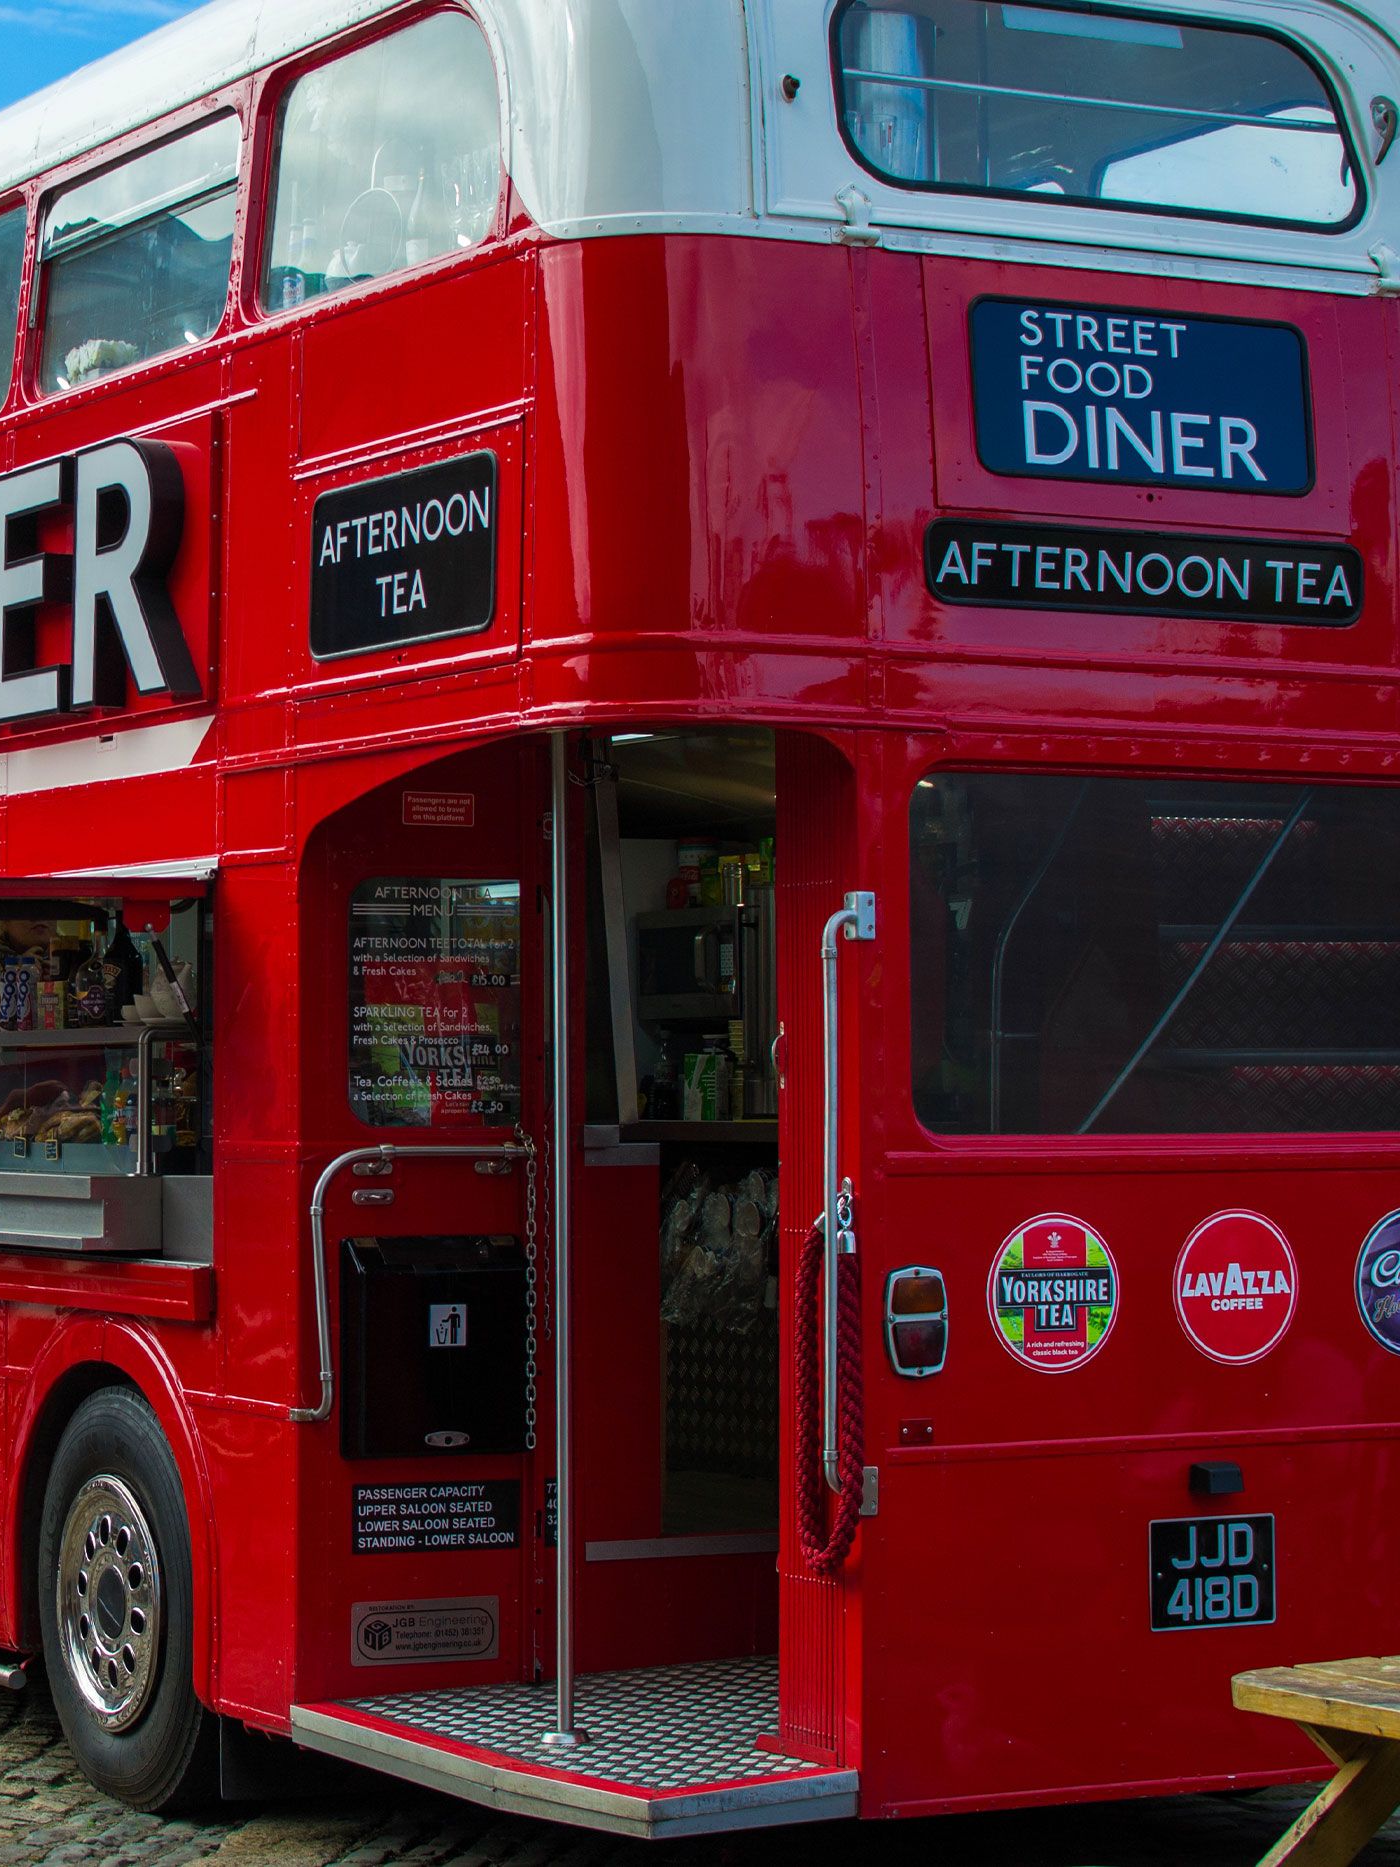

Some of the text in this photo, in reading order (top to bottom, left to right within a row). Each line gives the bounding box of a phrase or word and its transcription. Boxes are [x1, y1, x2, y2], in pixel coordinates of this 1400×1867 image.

[1019, 310, 1186, 358] STREET
[1020, 355, 1152, 399] FOOD
[1023, 400, 1267, 481] DINER
[319, 486, 489, 567] AFTERNOON
[936, 540, 1353, 606] AFTERNOON TEA
[376, 569, 426, 617] TEA
[407, 796, 446, 806] Passengers
[436, 814, 464, 822] platform
[374, 887, 492, 899] AFTERNOON TEA
[412, 905, 454, 916] MENU
[353, 937, 427, 949] AFTERNOON
[430, 938, 485, 949] TEETOTAL
[353, 953, 373, 963] with
[383, 953, 424, 963] Selection
[427, 953, 437, 963] of
[440, 953, 490, 963] Sandwiches
[353, 966, 417, 976] & Fresh Cakes
[472, 975, 506, 986] £15.00
[353, 1006, 468, 1018] SPARKLING TEA for 2
[353, 1022, 373, 1032] with
[383, 1022, 424, 1032] Selection
[427, 1022, 437, 1032] of
[440, 1023, 492, 1033] Sandwiches,
[353, 1036, 459, 1045] Fresh Cakes & Prosecco
[702, 1070, 716, 1100] milk
[361, 1091, 402, 1100] Selection
[405, 1091, 416, 1100] of
[418, 1091, 442, 1100] Fresh
[444, 1091, 472, 1100] Cakes
[1182, 1263, 1291, 1297] LAVAZZA
[1002, 1276, 1108, 1303] YORKSHIRE
[1211, 1298, 1263, 1311] COFFEE
[1037, 1304, 1073, 1326] TEA
[358, 1485, 485, 1500] PASSENGER CAPACITY
[358, 1501, 492, 1516] UPPER SALOON SEATED
[358, 1517, 495, 1532] LOWER SALOON SEATED
[358, 1532, 514, 1549] STANDING LOWER SALOON
[1171, 1523, 1253, 1569] JJD
[1167, 1574, 1259, 1621] 418D
[392, 1615, 488, 1628] JGB Engineering
[395, 1630, 431, 1640] Telephone:
